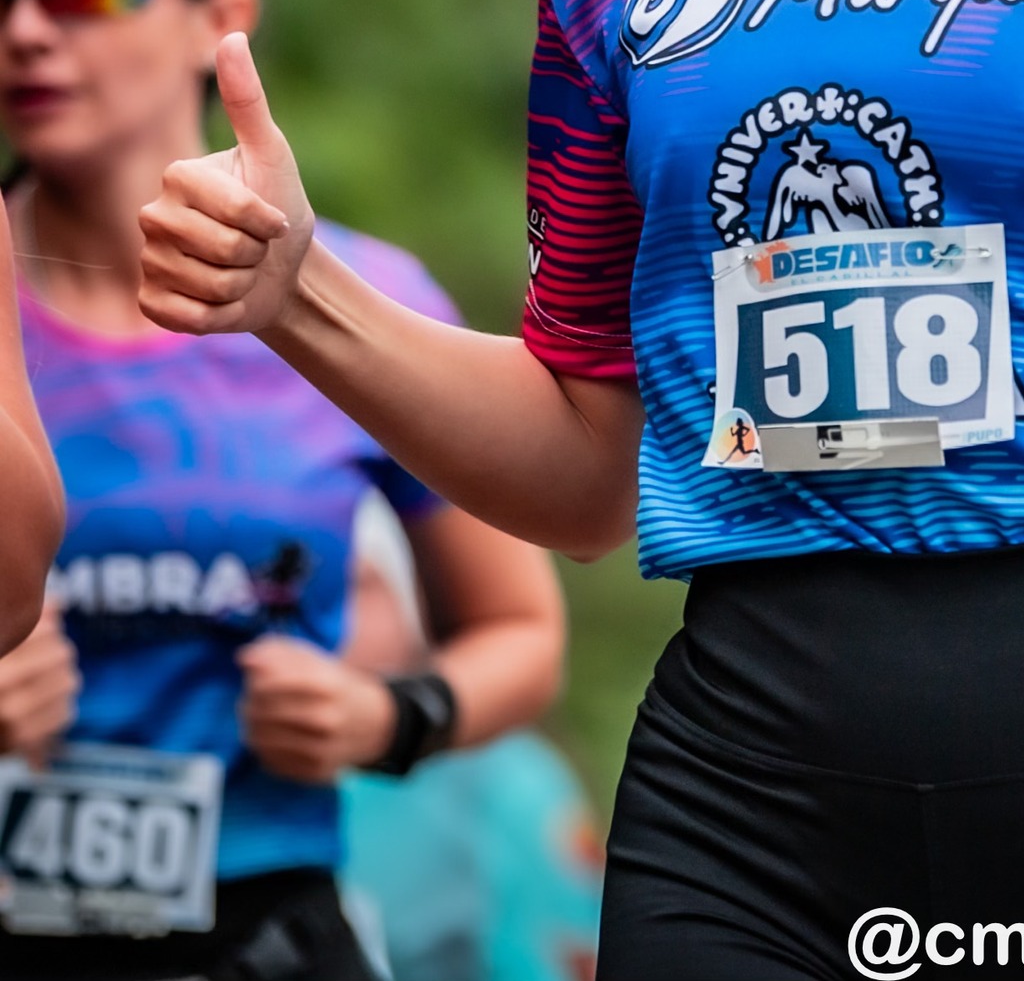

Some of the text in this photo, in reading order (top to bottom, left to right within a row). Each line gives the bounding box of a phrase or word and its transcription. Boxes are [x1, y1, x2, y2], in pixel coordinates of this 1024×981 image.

[771, 240, 936, 280] DESAFIO
[763, 294, 982, 418] 518
[12, 794, 190, 890] 460
